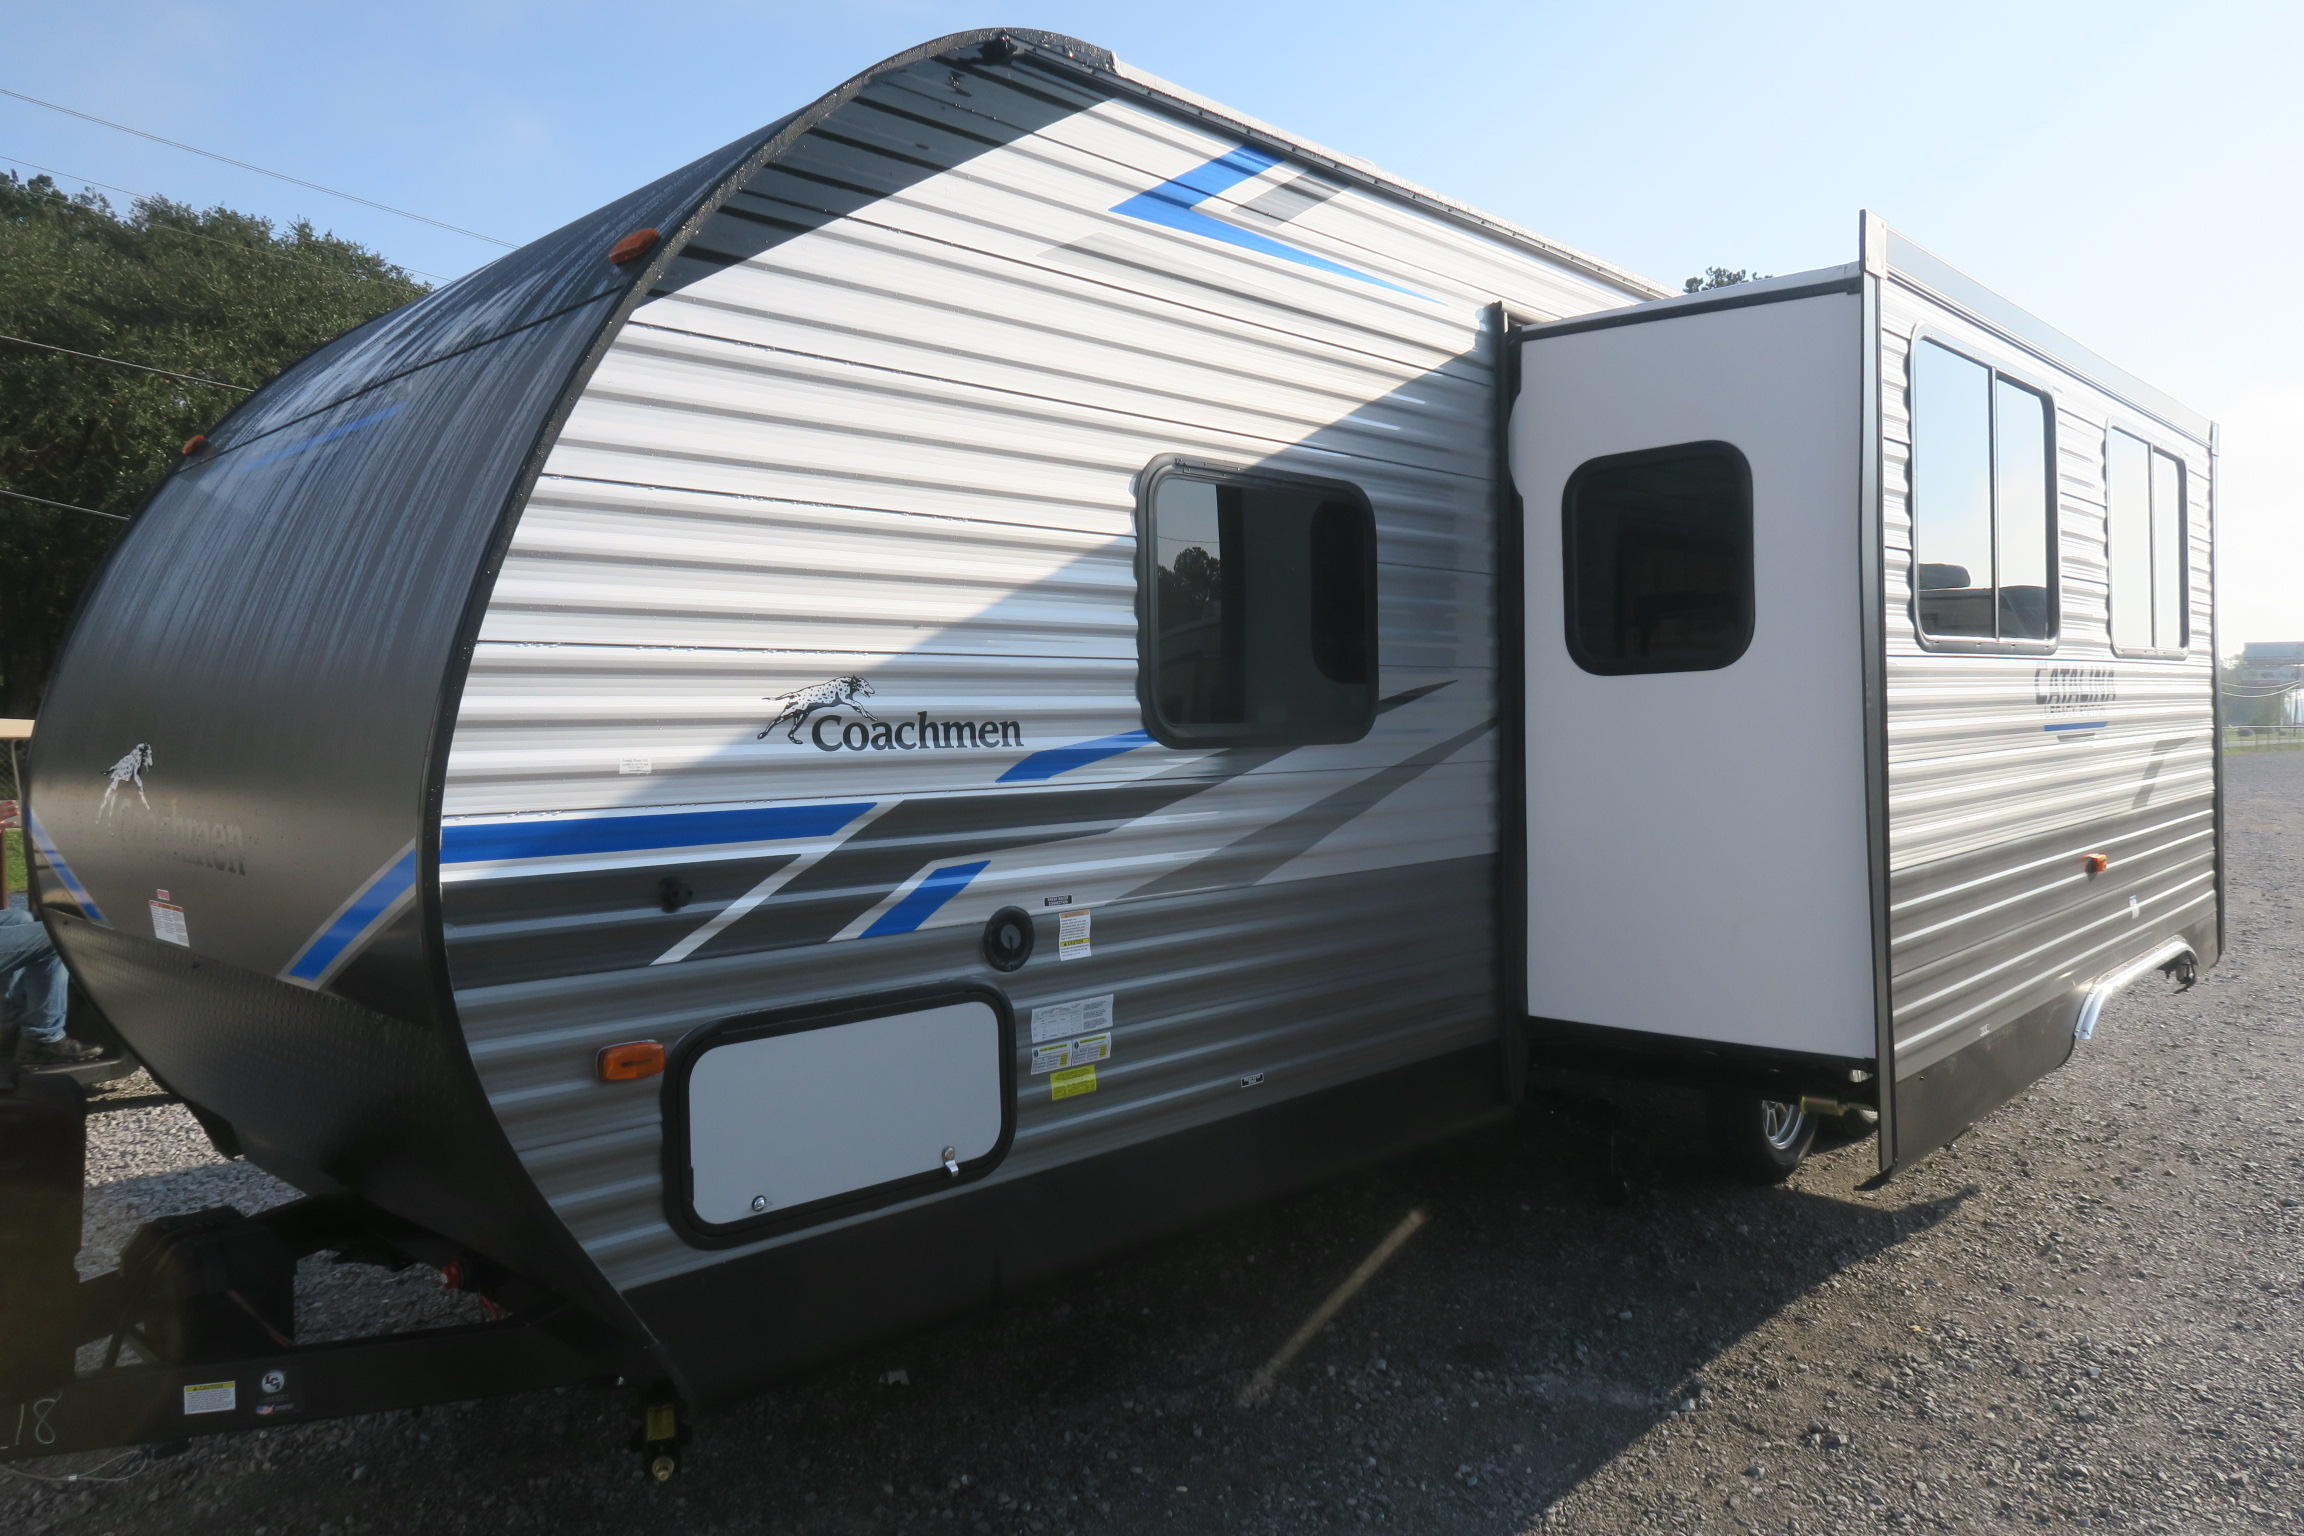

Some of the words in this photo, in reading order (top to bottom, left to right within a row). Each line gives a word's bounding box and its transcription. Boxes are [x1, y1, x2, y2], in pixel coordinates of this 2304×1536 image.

[2034, 661, 2116, 705] CATALINA
[811, 711, 1025, 752] Coachmen
[0, 1391, 63, 1450] 18
